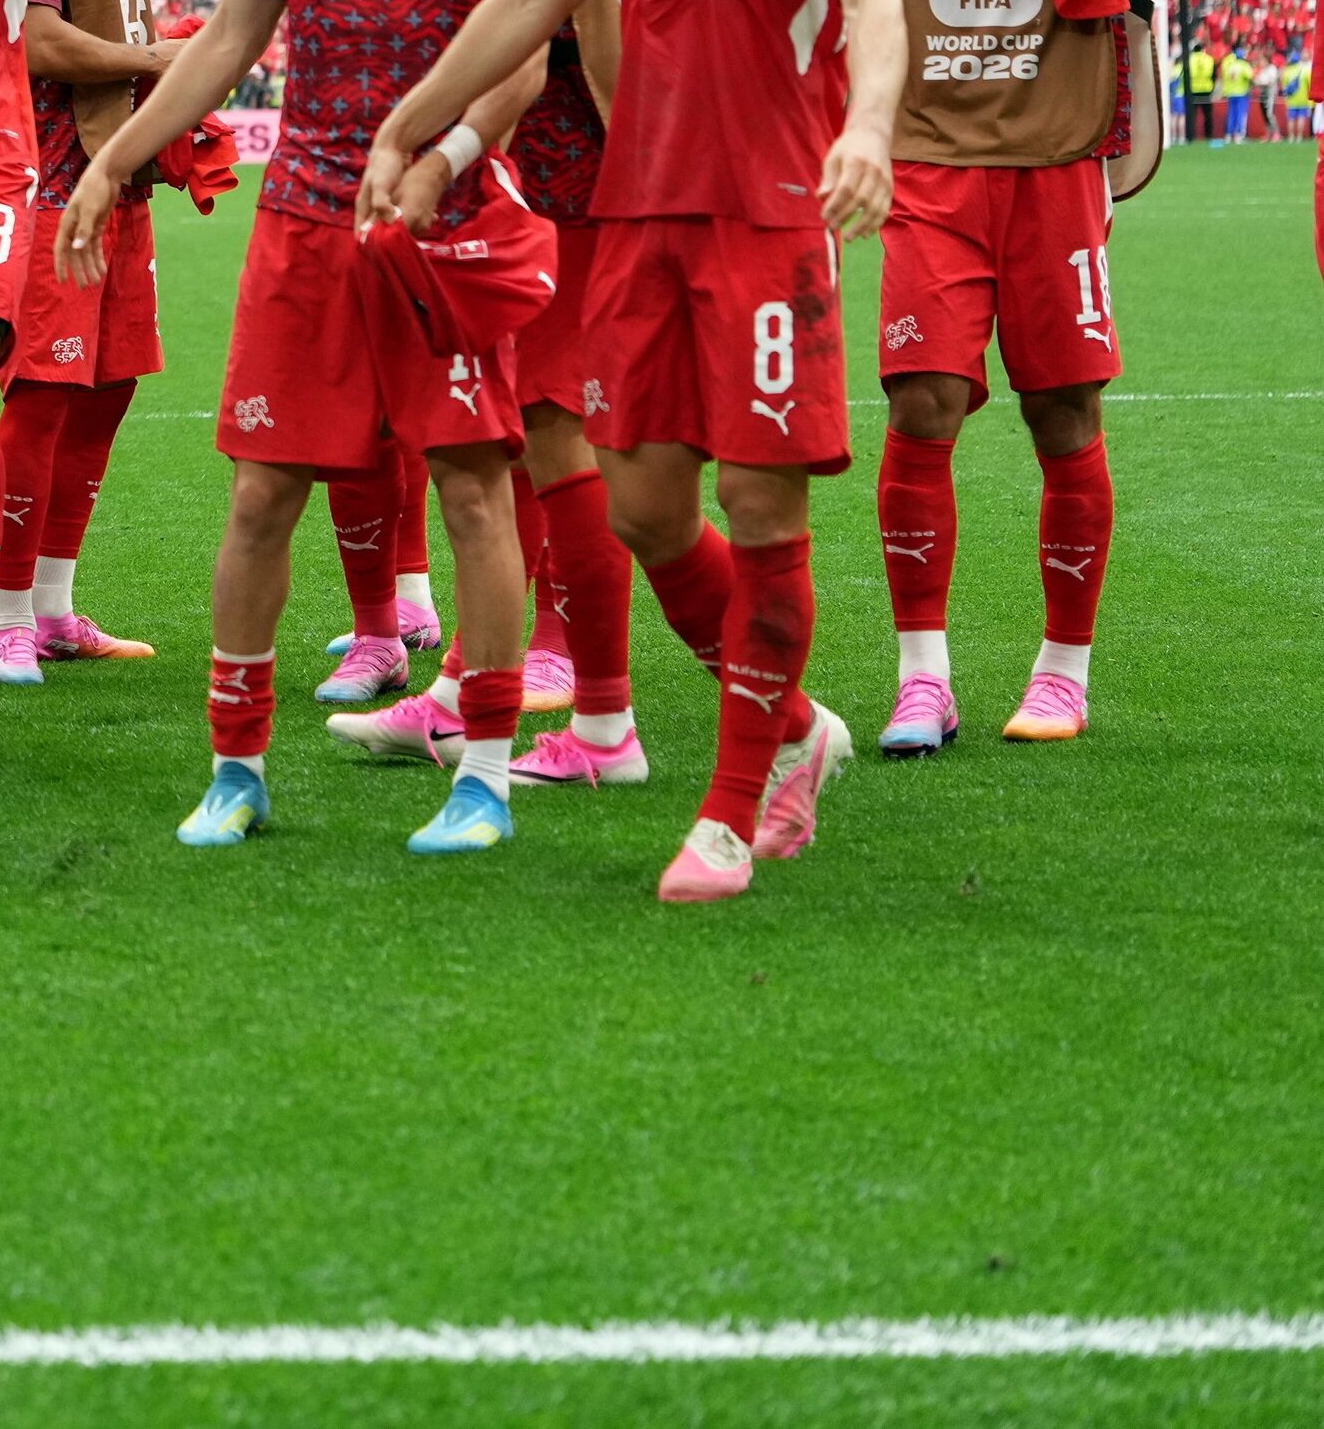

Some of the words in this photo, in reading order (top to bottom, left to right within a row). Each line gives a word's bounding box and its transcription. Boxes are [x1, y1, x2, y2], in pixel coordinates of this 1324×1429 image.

[926, 35, 998, 51] WORLD
[1002, 34, 1044, 51] CUP
[923, 53, 1040, 81] 2026
[753, 301, 794, 395] 8
